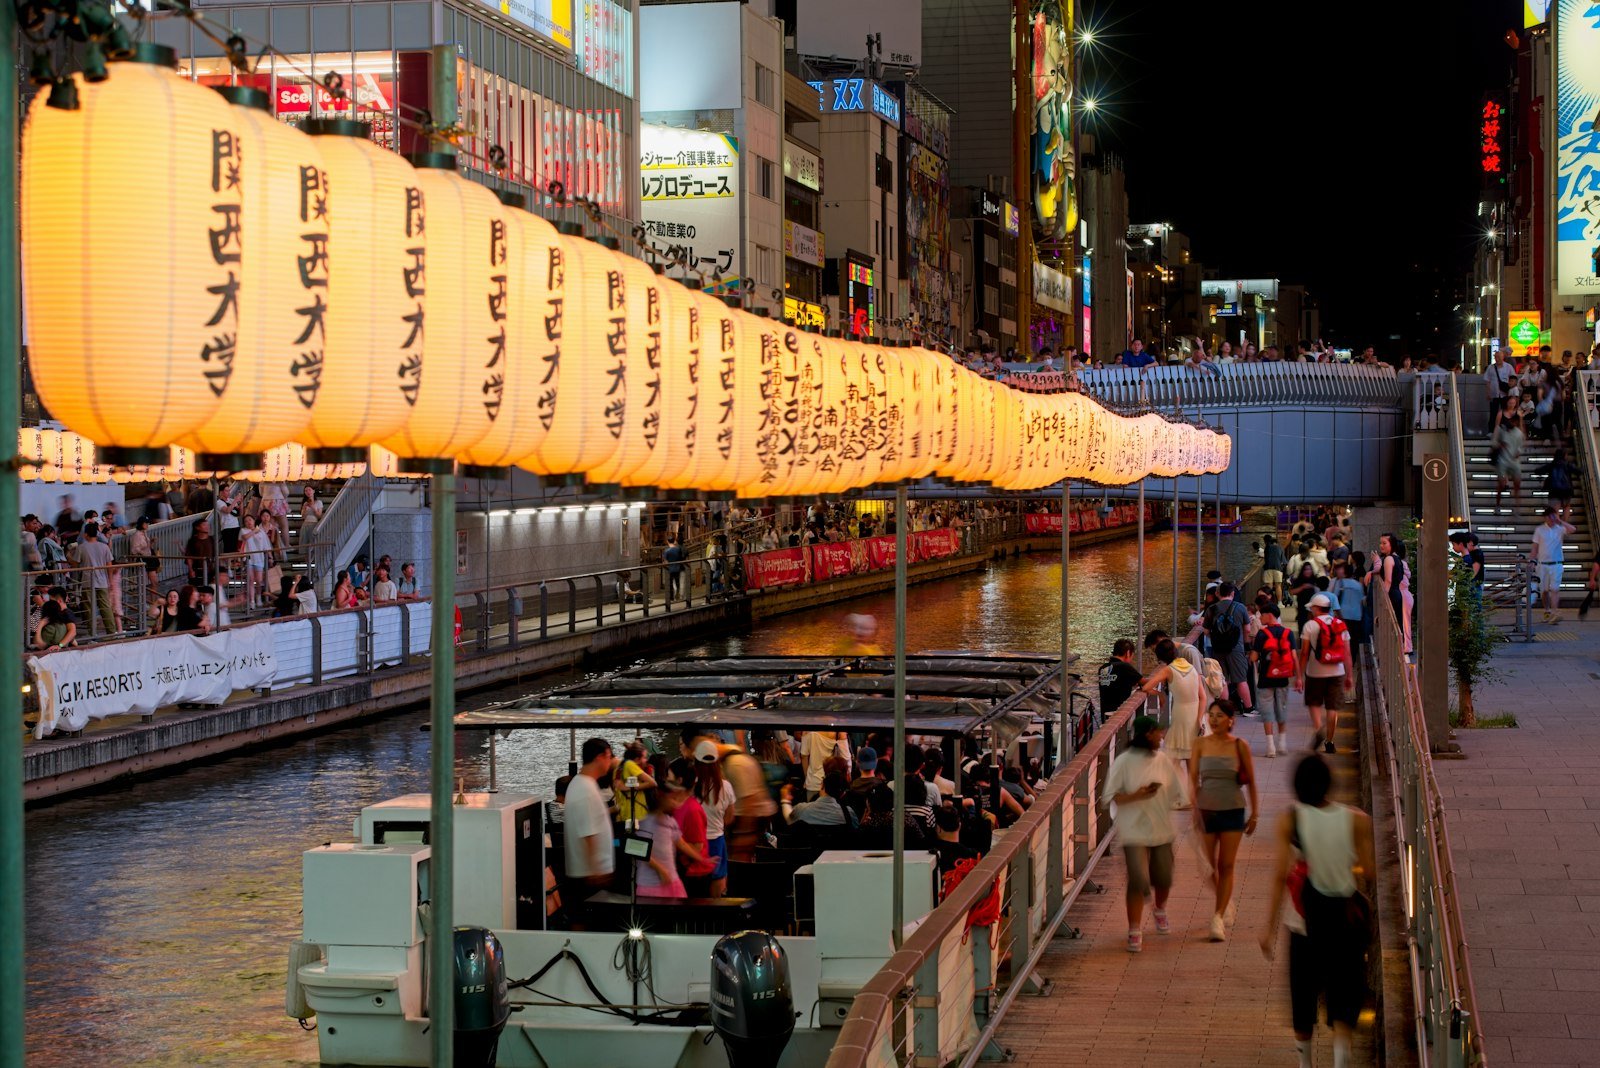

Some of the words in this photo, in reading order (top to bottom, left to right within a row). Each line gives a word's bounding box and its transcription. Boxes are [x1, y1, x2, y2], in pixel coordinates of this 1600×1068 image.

[1482, 101, 1500, 172] お好み焼
[86, 671, 143, 699] RESORTS
[461, 983, 486, 994] 115
[752, 989, 776, 1001] 115
